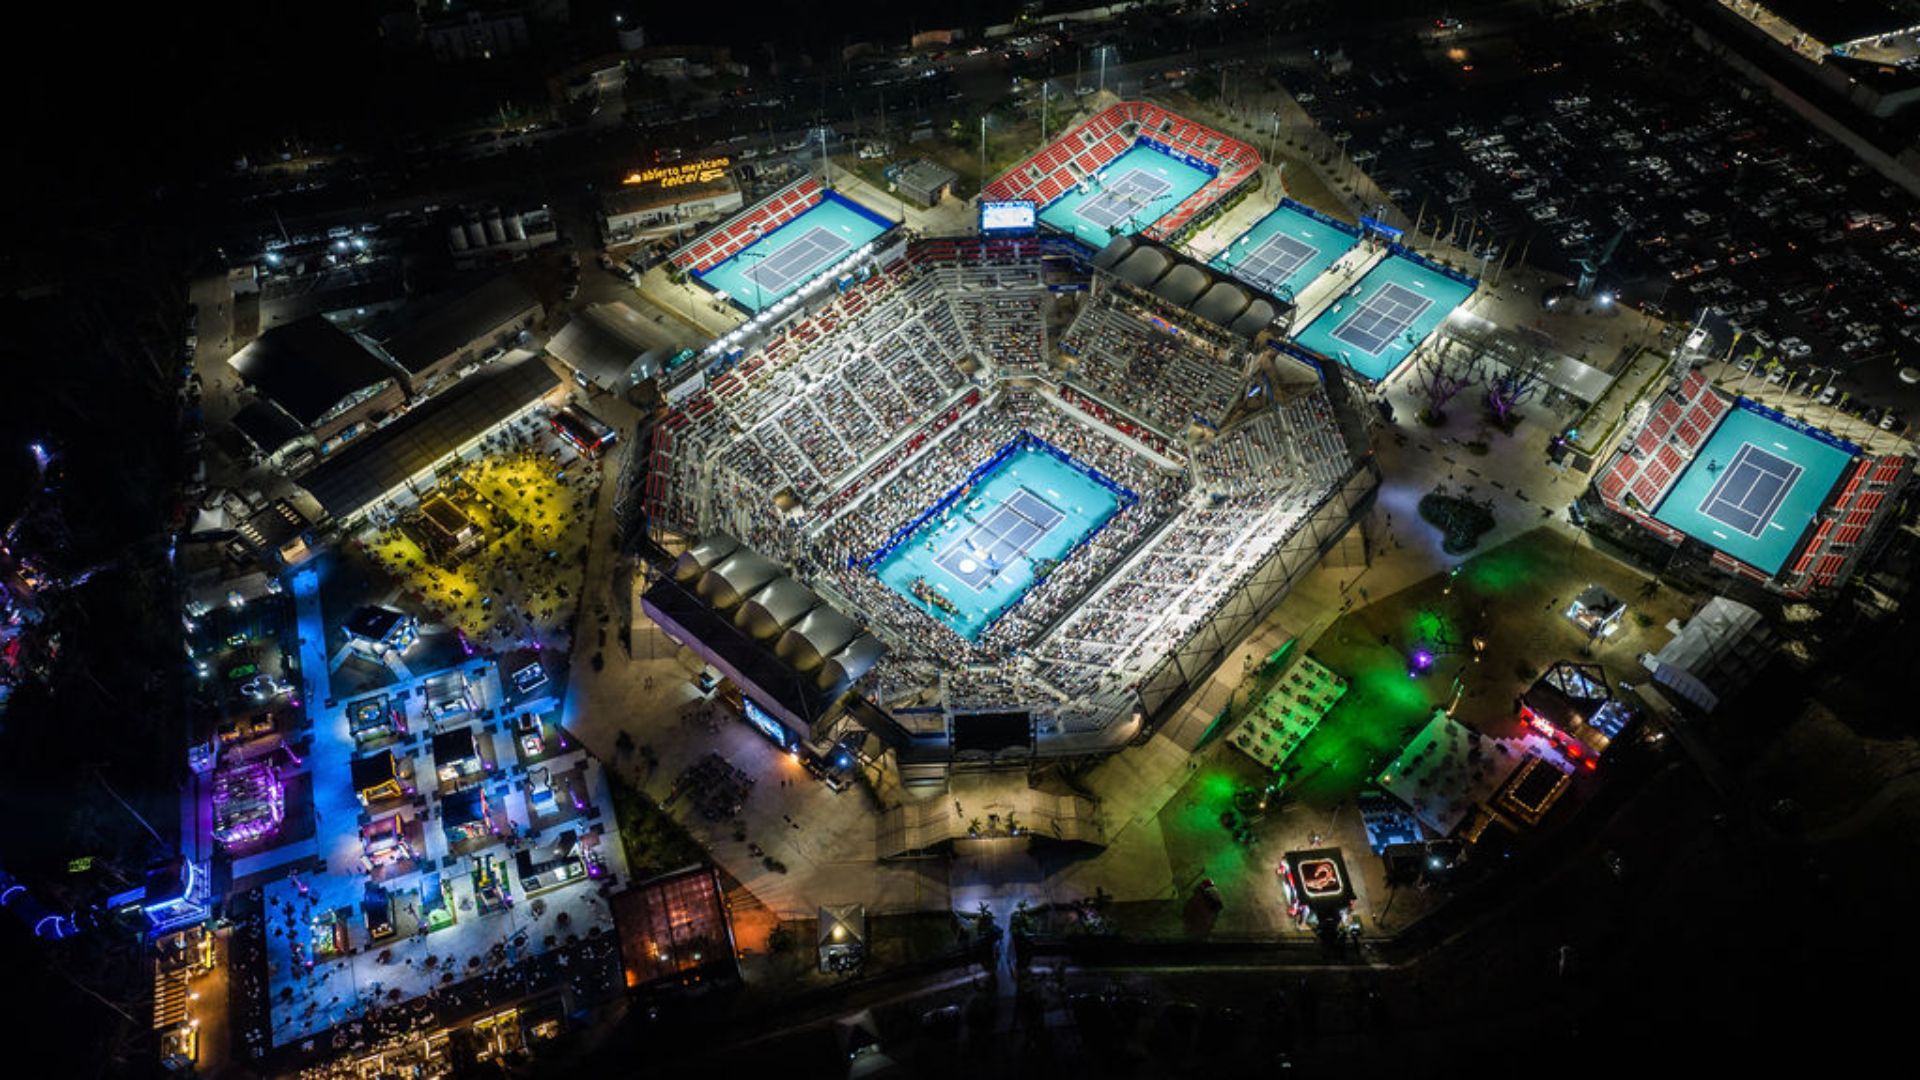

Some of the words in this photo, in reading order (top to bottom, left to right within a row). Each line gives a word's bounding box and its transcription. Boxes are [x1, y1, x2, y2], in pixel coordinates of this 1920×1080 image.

[642, 168, 679, 181] abierto
[682, 158, 729, 173] mexicano
[661, 170, 698, 188] telcel
